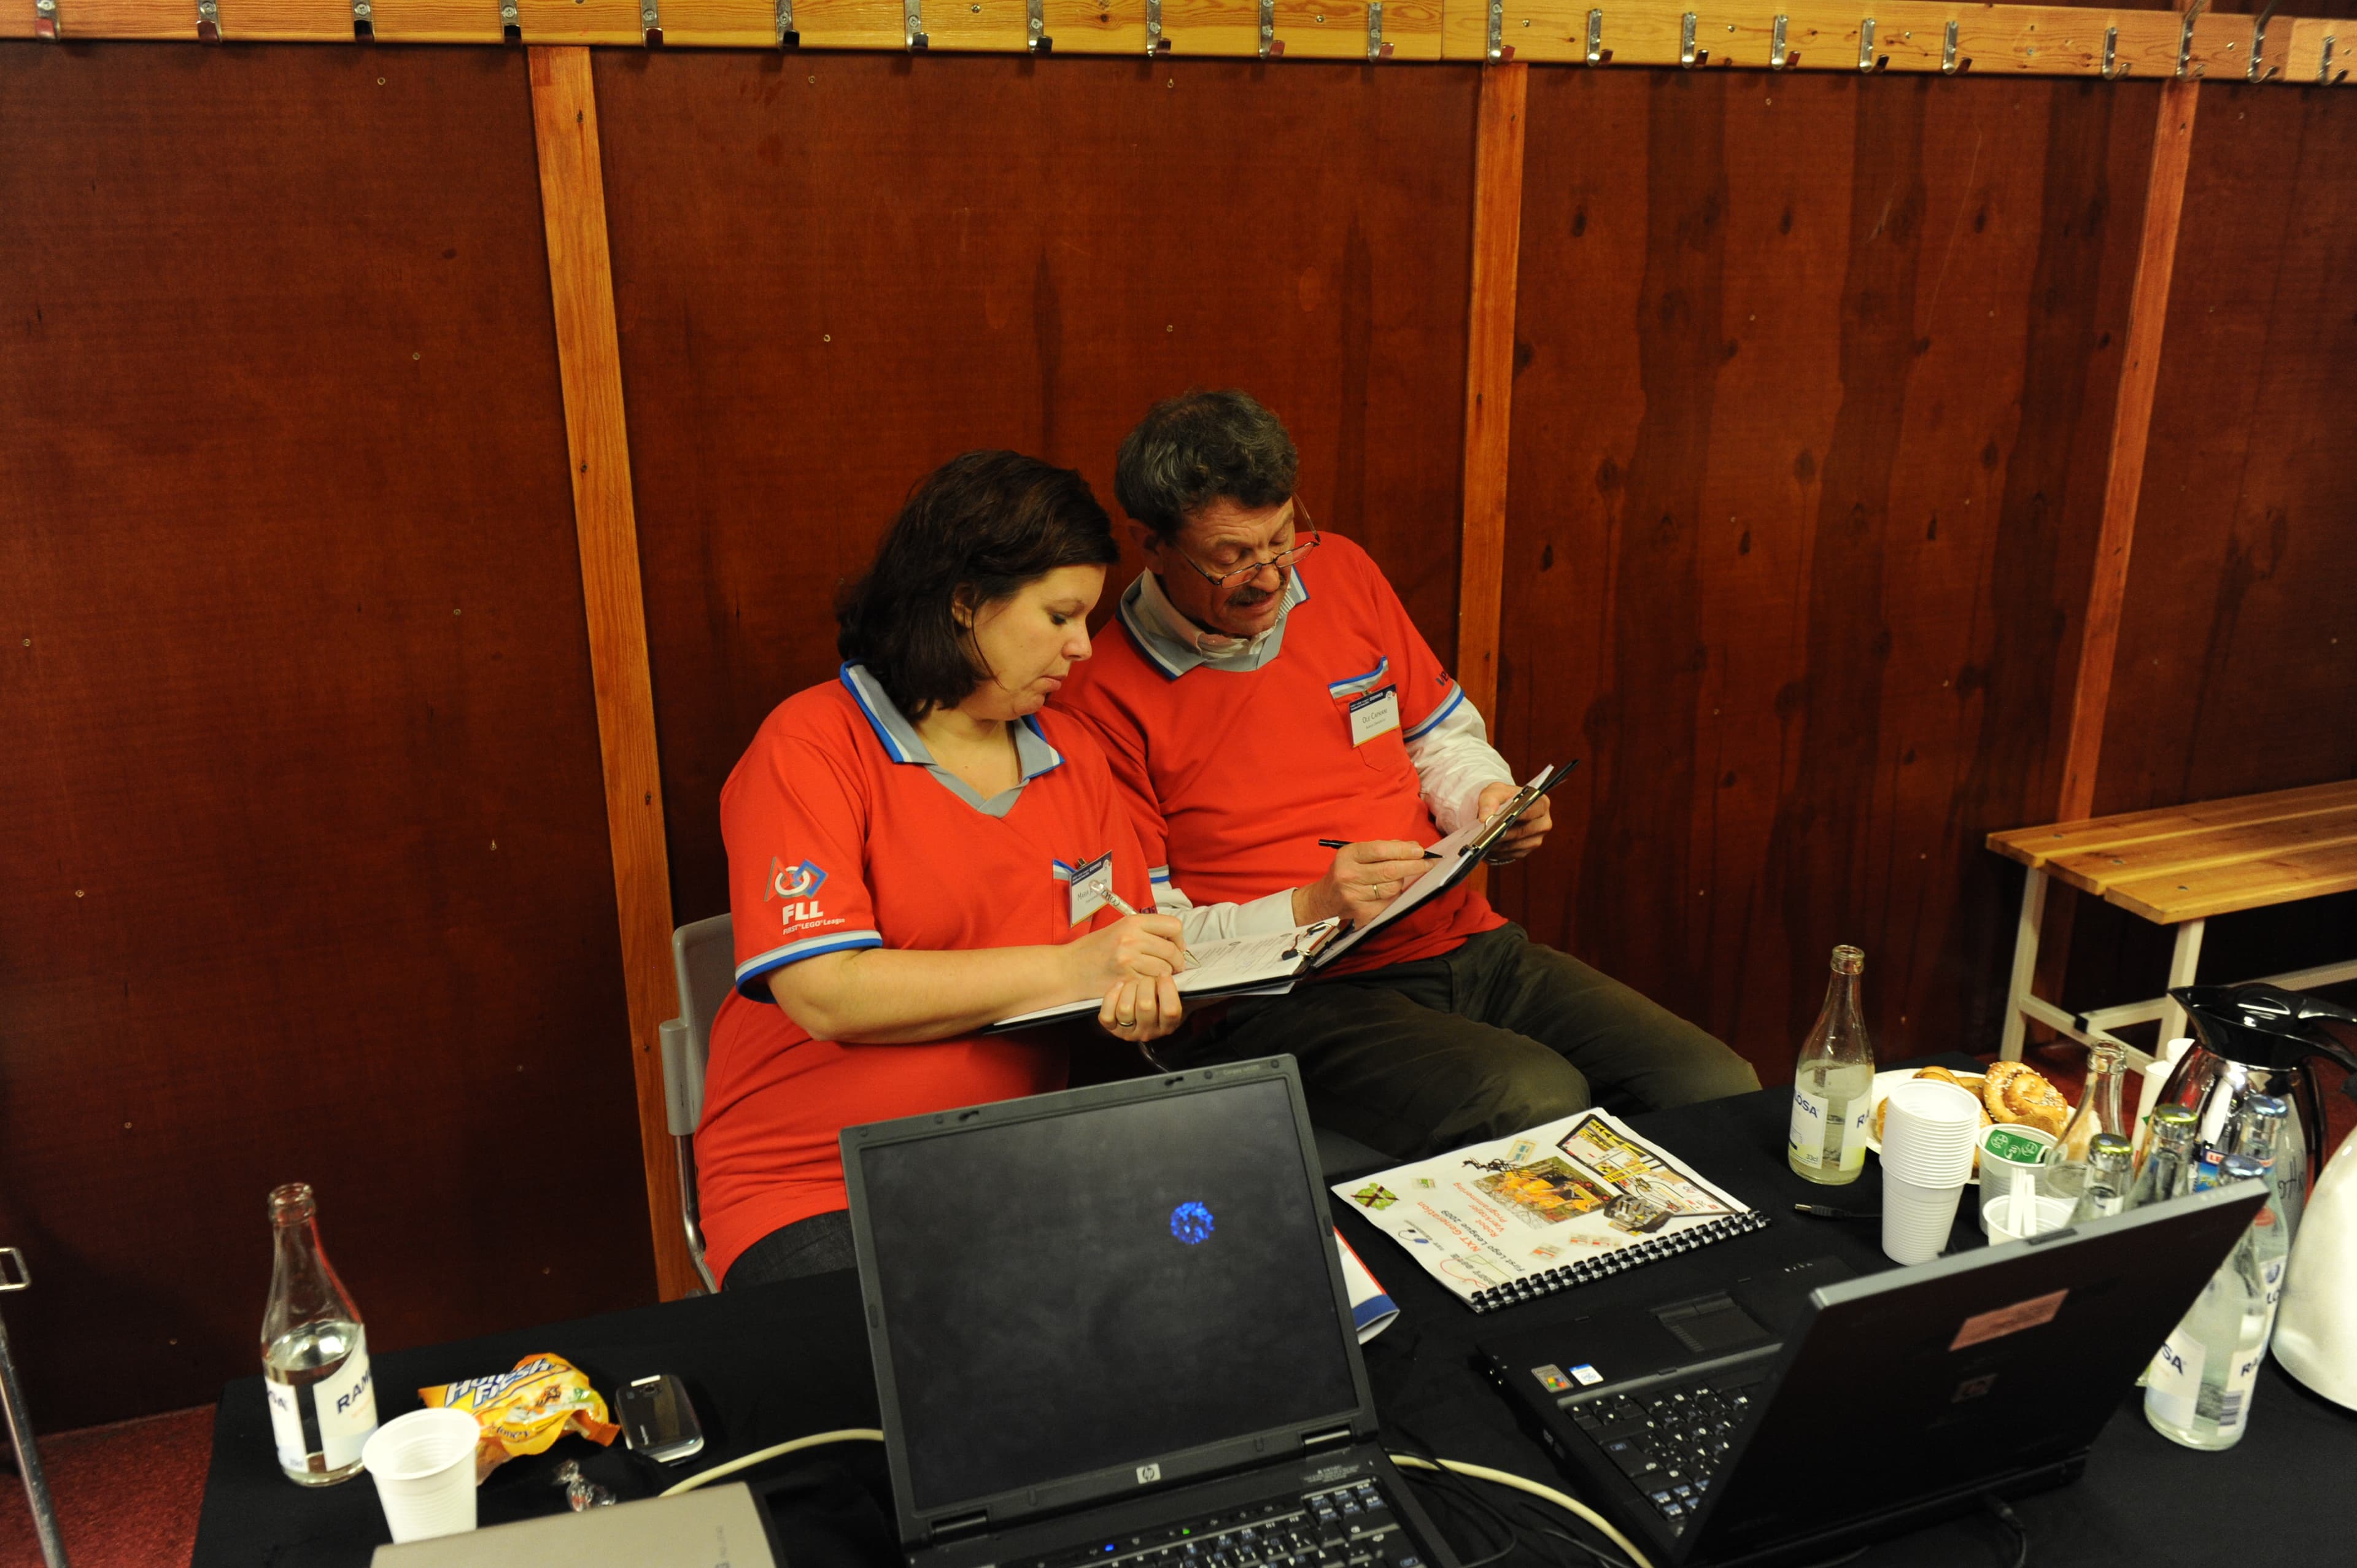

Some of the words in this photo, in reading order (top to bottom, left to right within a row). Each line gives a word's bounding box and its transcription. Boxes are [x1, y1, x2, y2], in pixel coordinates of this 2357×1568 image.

[783, 900, 824, 925] FLL
[783, 924, 800, 935] FIRST
[801, 921, 820, 930] LEGO
[1417, 1201, 1462, 1235] Generation
[1441, 1210, 1461, 1223] 2009
[1461, 1222, 1488, 1246] League
[1476, 1219, 1499, 1237] Robot
[1459, 1237, 1482, 1252] NXT
[1487, 1245, 1506, 1259] Lego
[1505, 1258, 1525, 1272] First
